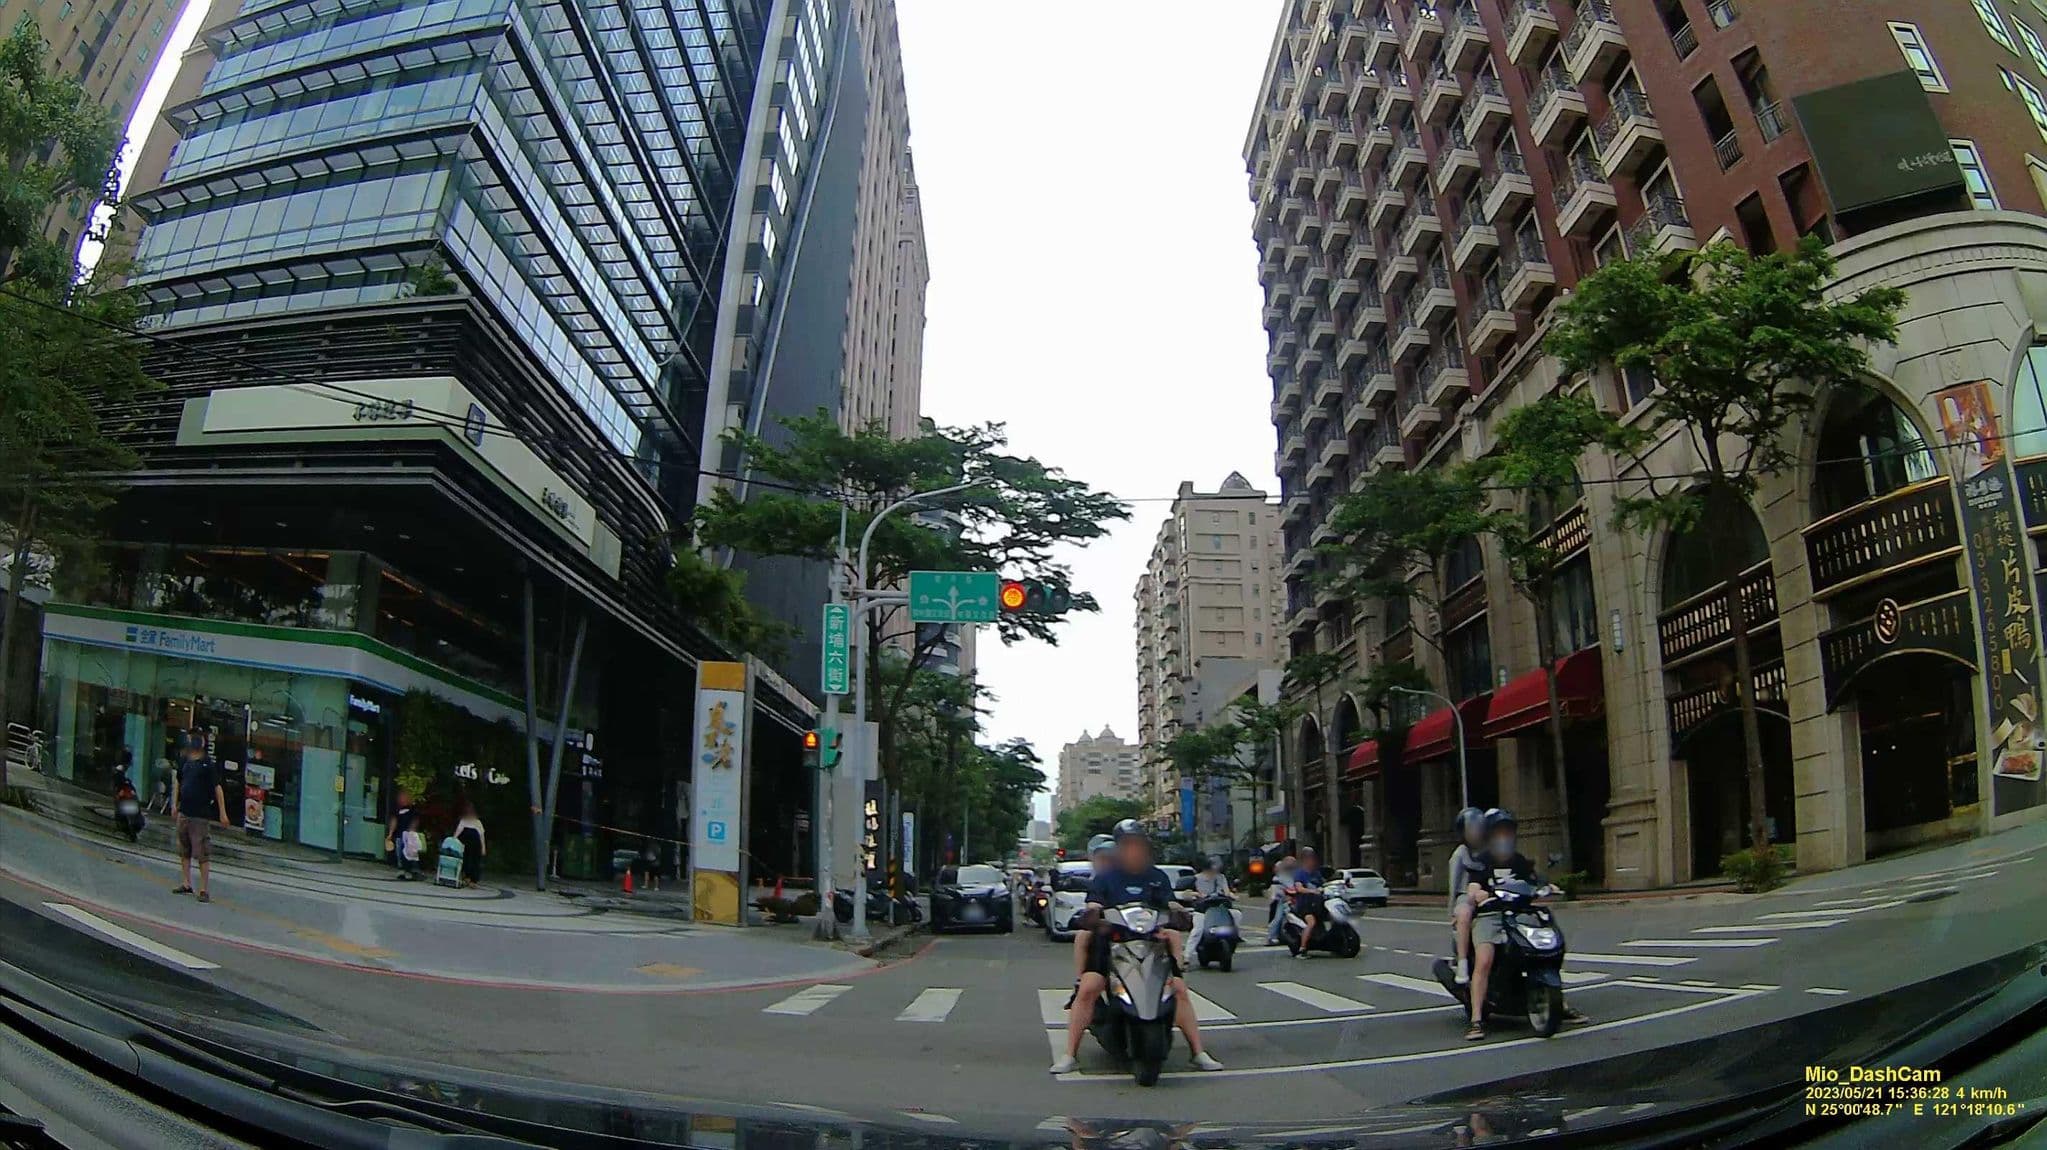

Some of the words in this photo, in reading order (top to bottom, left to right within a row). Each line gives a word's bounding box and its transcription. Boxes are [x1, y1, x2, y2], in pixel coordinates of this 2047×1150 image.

[159, 631, 216, 653] FamilyMart
[827, 613, 845, 681] 新埔六街
